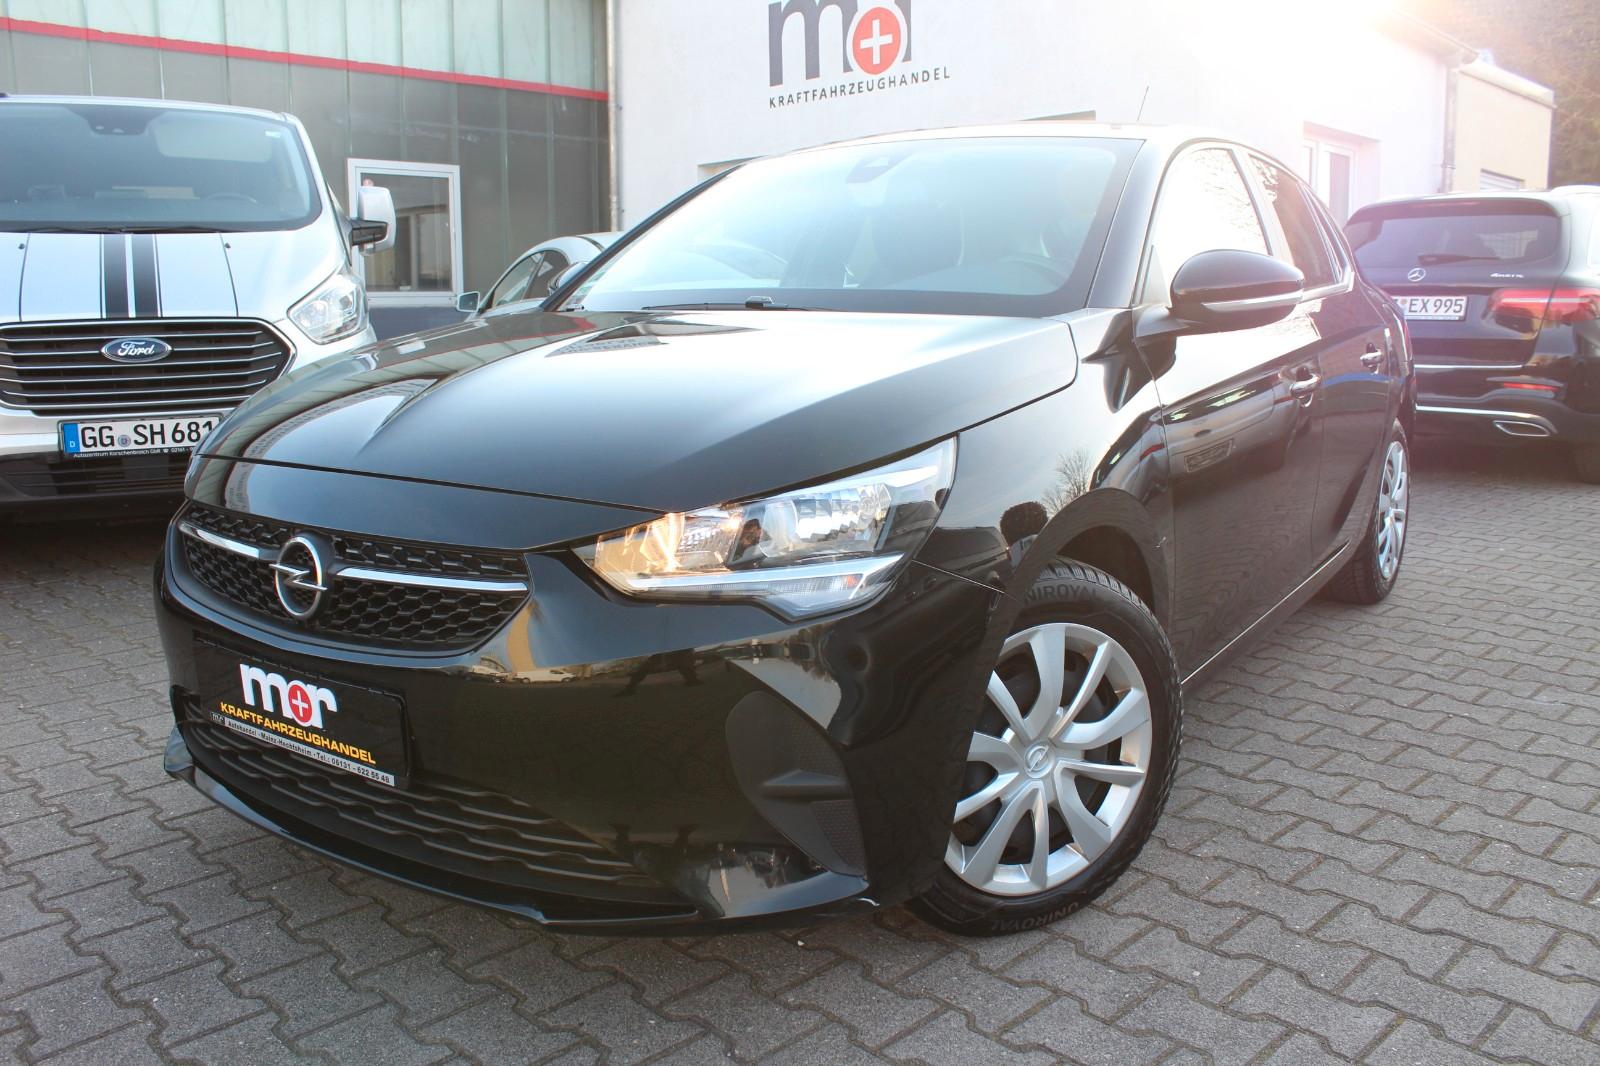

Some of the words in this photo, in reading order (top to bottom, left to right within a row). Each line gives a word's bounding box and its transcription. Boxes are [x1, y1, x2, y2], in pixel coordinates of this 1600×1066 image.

[769, 66, 951, 109] KRAFTFAHRZEUGHANDEL
[1408, 298, 1429, 313] EX
[1433, 298, 1464, 313] 995
[118, 341, 155, 356] Ford
[80, 426, 115, 448] GG
[133, 423, 166, 446] SH
[220, 702, 377, 765] KRAFTFAHRZEUGHANDEL
[228, 720, 257, 737] Autohandel
[991, 902, 1079, 931] UNIROYAL
